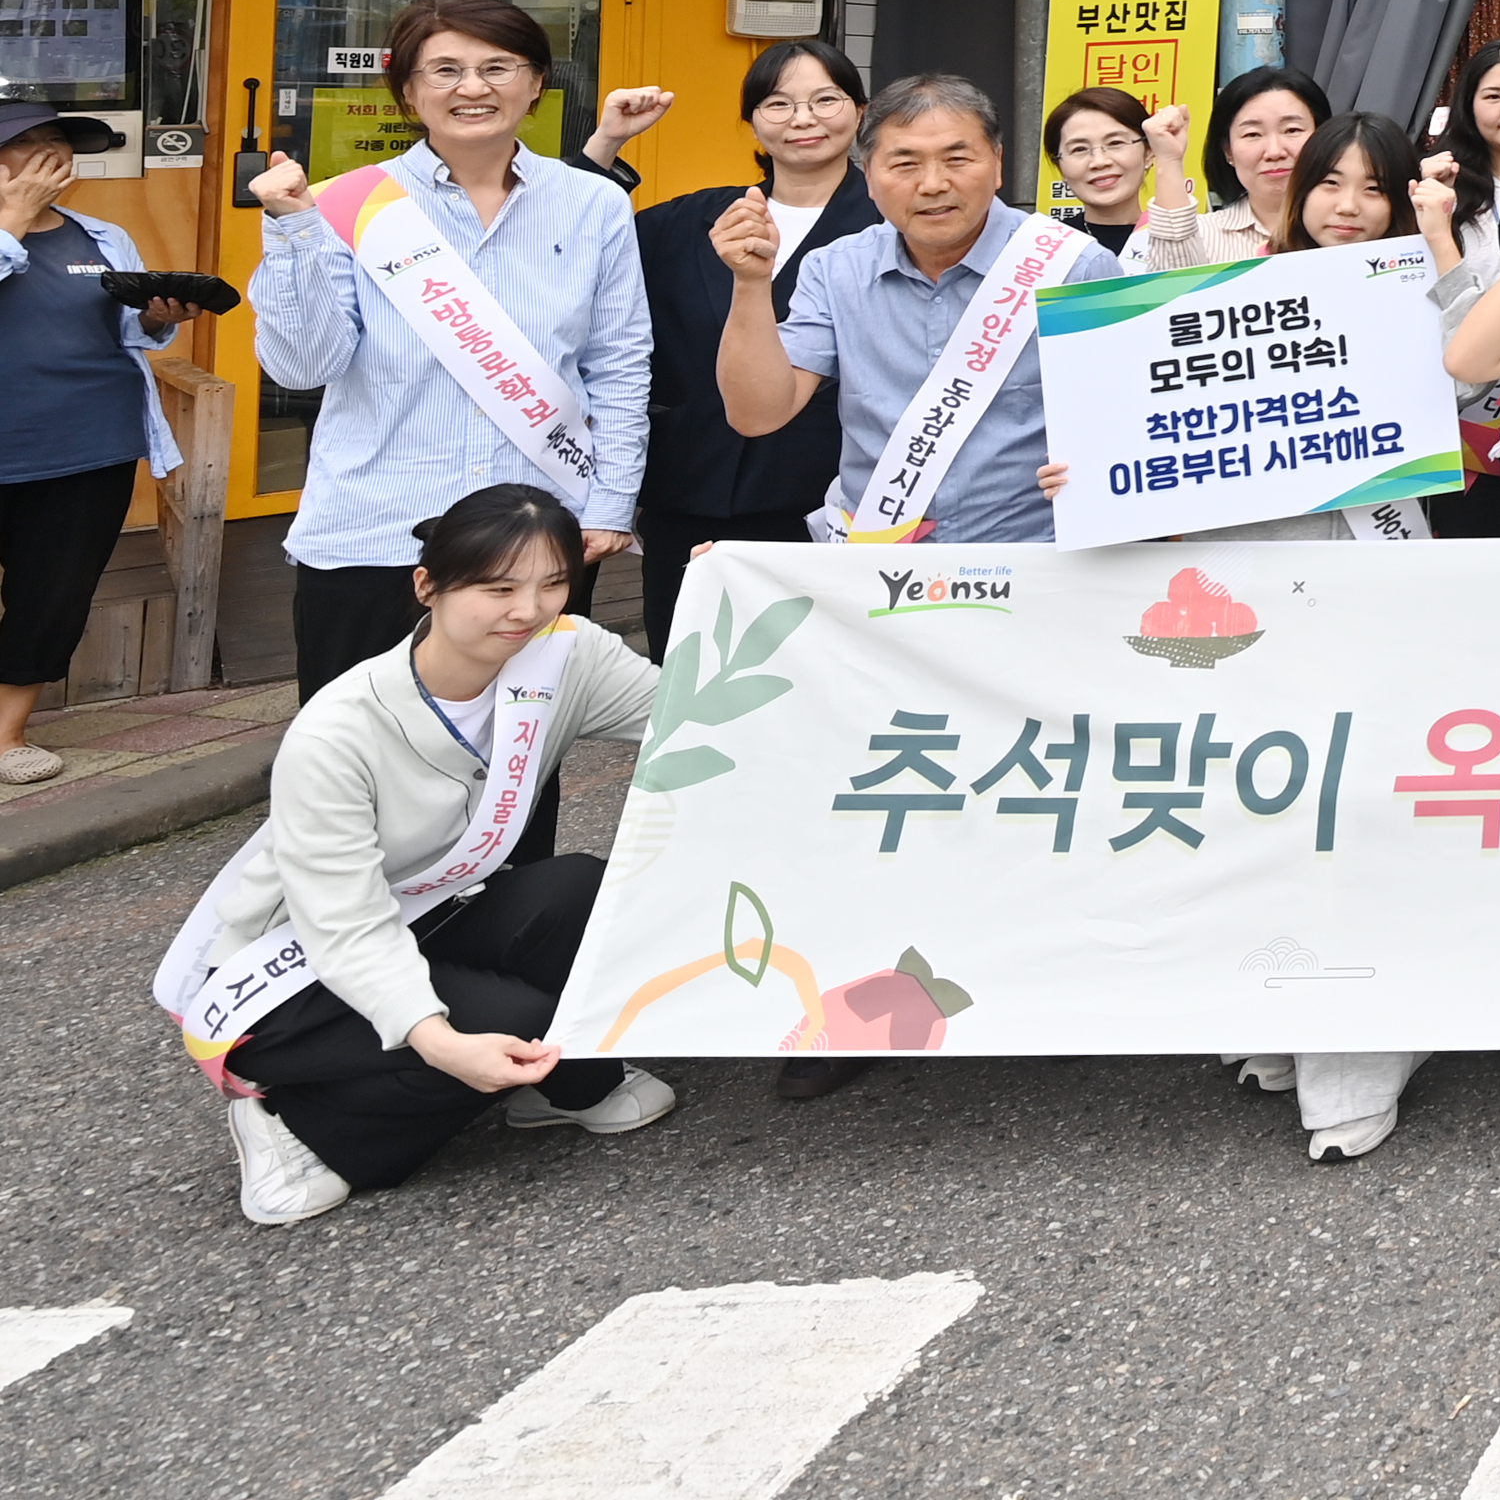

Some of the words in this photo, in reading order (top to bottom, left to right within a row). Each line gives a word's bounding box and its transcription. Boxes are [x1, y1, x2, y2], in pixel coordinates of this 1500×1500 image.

[1076, 0, 1188, 35] 부산맛집
[334, 52, 375, 69] 직원외
[1097, 52, 1161, 85] 달인
[347, 104, 378, 117] 저희
[354, 139, 384, 152] 각종
[377, 244, 443, 276] Yeonsu
[1366, 253, 1426, 273] Yeonsu
[1400, 271, 1426, 282] 연수구
[962, 220, 1077, 374] 지역물가안정
[1167, 295, 1322, 348] 물가안정,
[420, 277, 560, 429] 소방통로확보
[1150, 350, 1256, 395] 모두의
[1269, 335, 1348, 384] 약속!
[1146, 385, 1360, 444] 착한가격업소
[879, 376, 972, 528] 동참합시다
[1109, 452, 1252, 500] 이용부터
[1264, 422, 1404, 475] 시작해요
[876, 570, 1011, 608] Yeonsu
[832, 711, 1355, 853] 추석맞이
